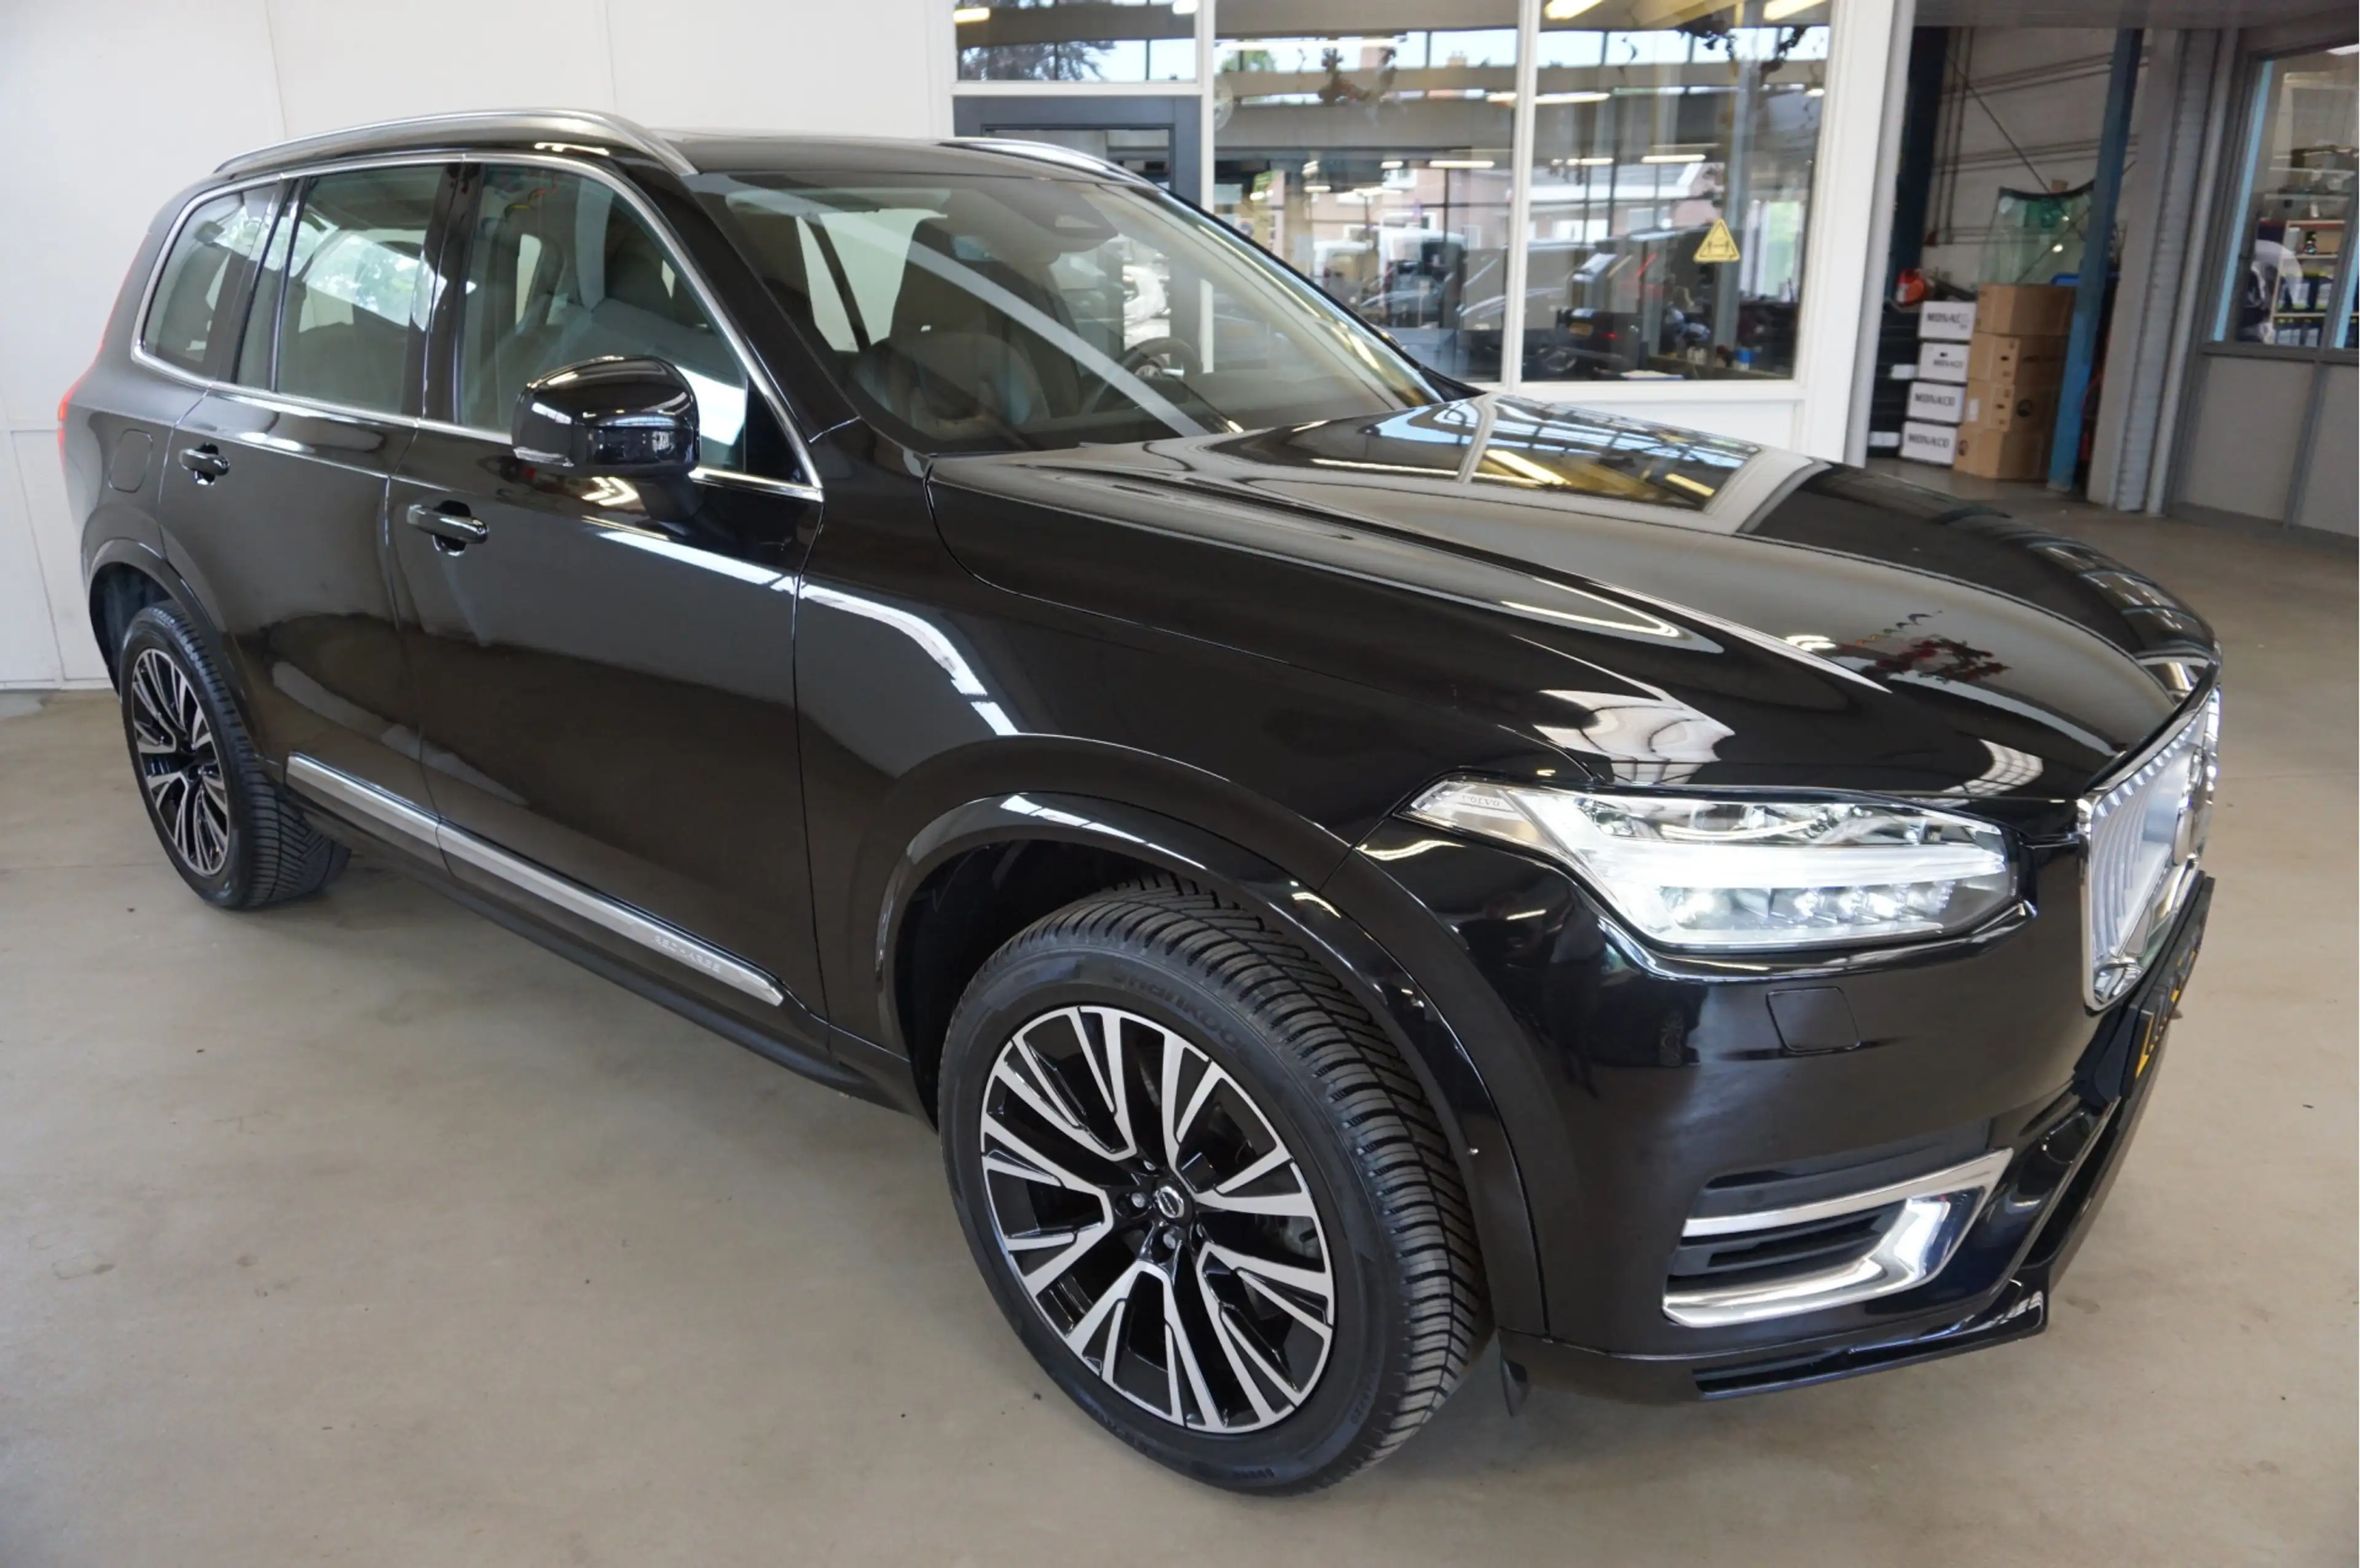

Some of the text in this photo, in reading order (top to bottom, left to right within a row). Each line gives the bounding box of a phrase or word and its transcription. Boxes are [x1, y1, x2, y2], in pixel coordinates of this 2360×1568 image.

[1927, 312, 1967, 325] MONAC
[1914, 393, 1956, 406] MONACO
[1908, 433, 1949, 448] MONACO
